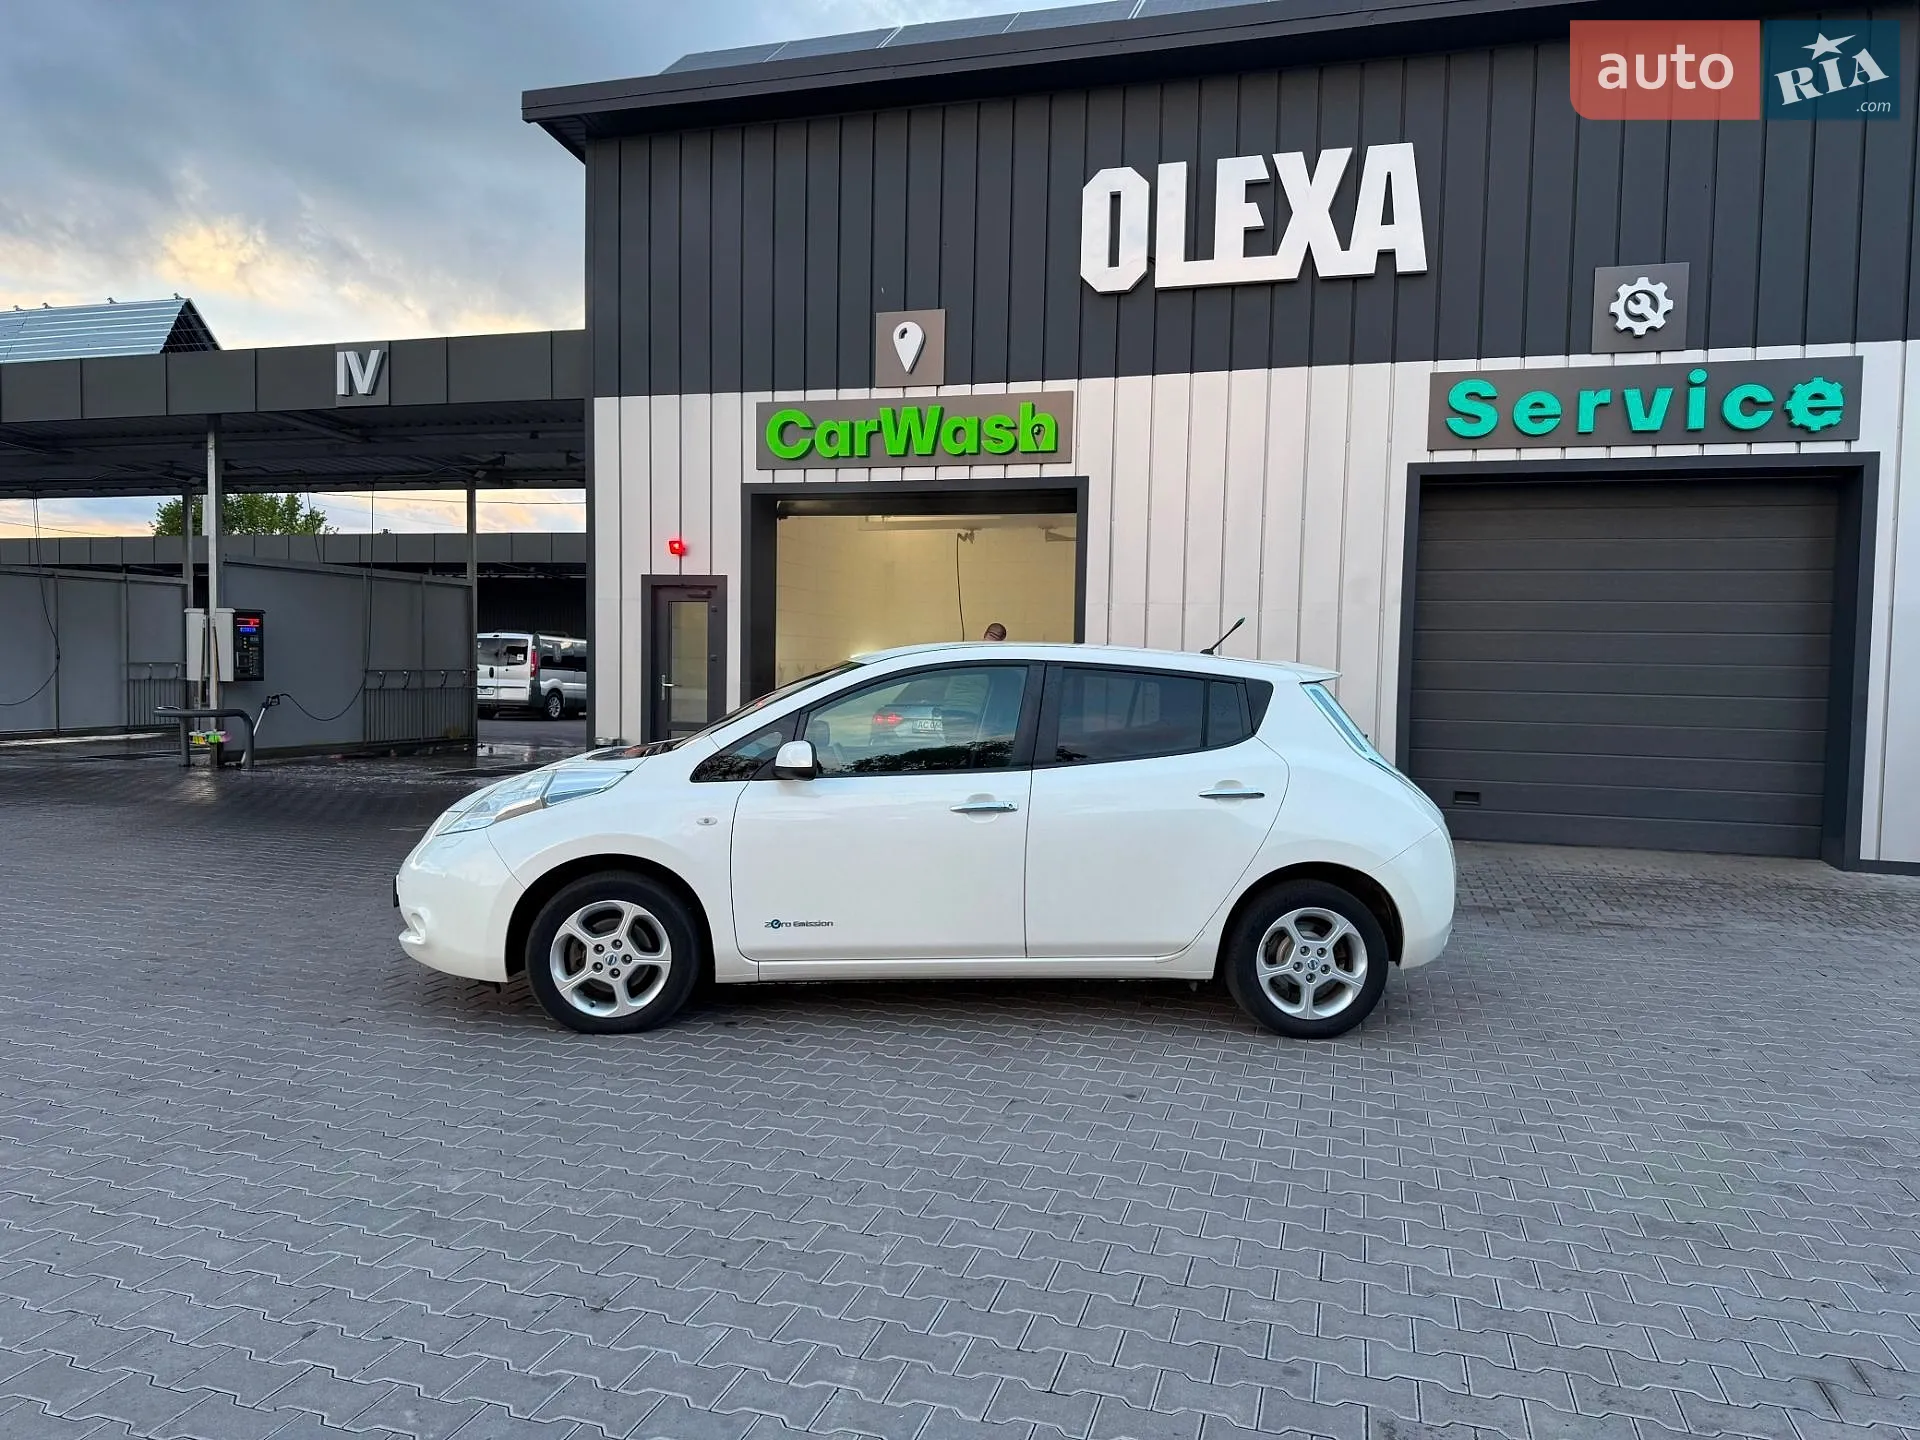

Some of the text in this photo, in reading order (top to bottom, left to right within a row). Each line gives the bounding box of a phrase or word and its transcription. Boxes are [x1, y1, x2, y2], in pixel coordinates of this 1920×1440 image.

[1080, 142, 1428, 293] OLEXA
[336, 349, 384, 395] IV
[1444, 368, 1845, 438] Service
[765, 402, 1059, 460] CarWash
